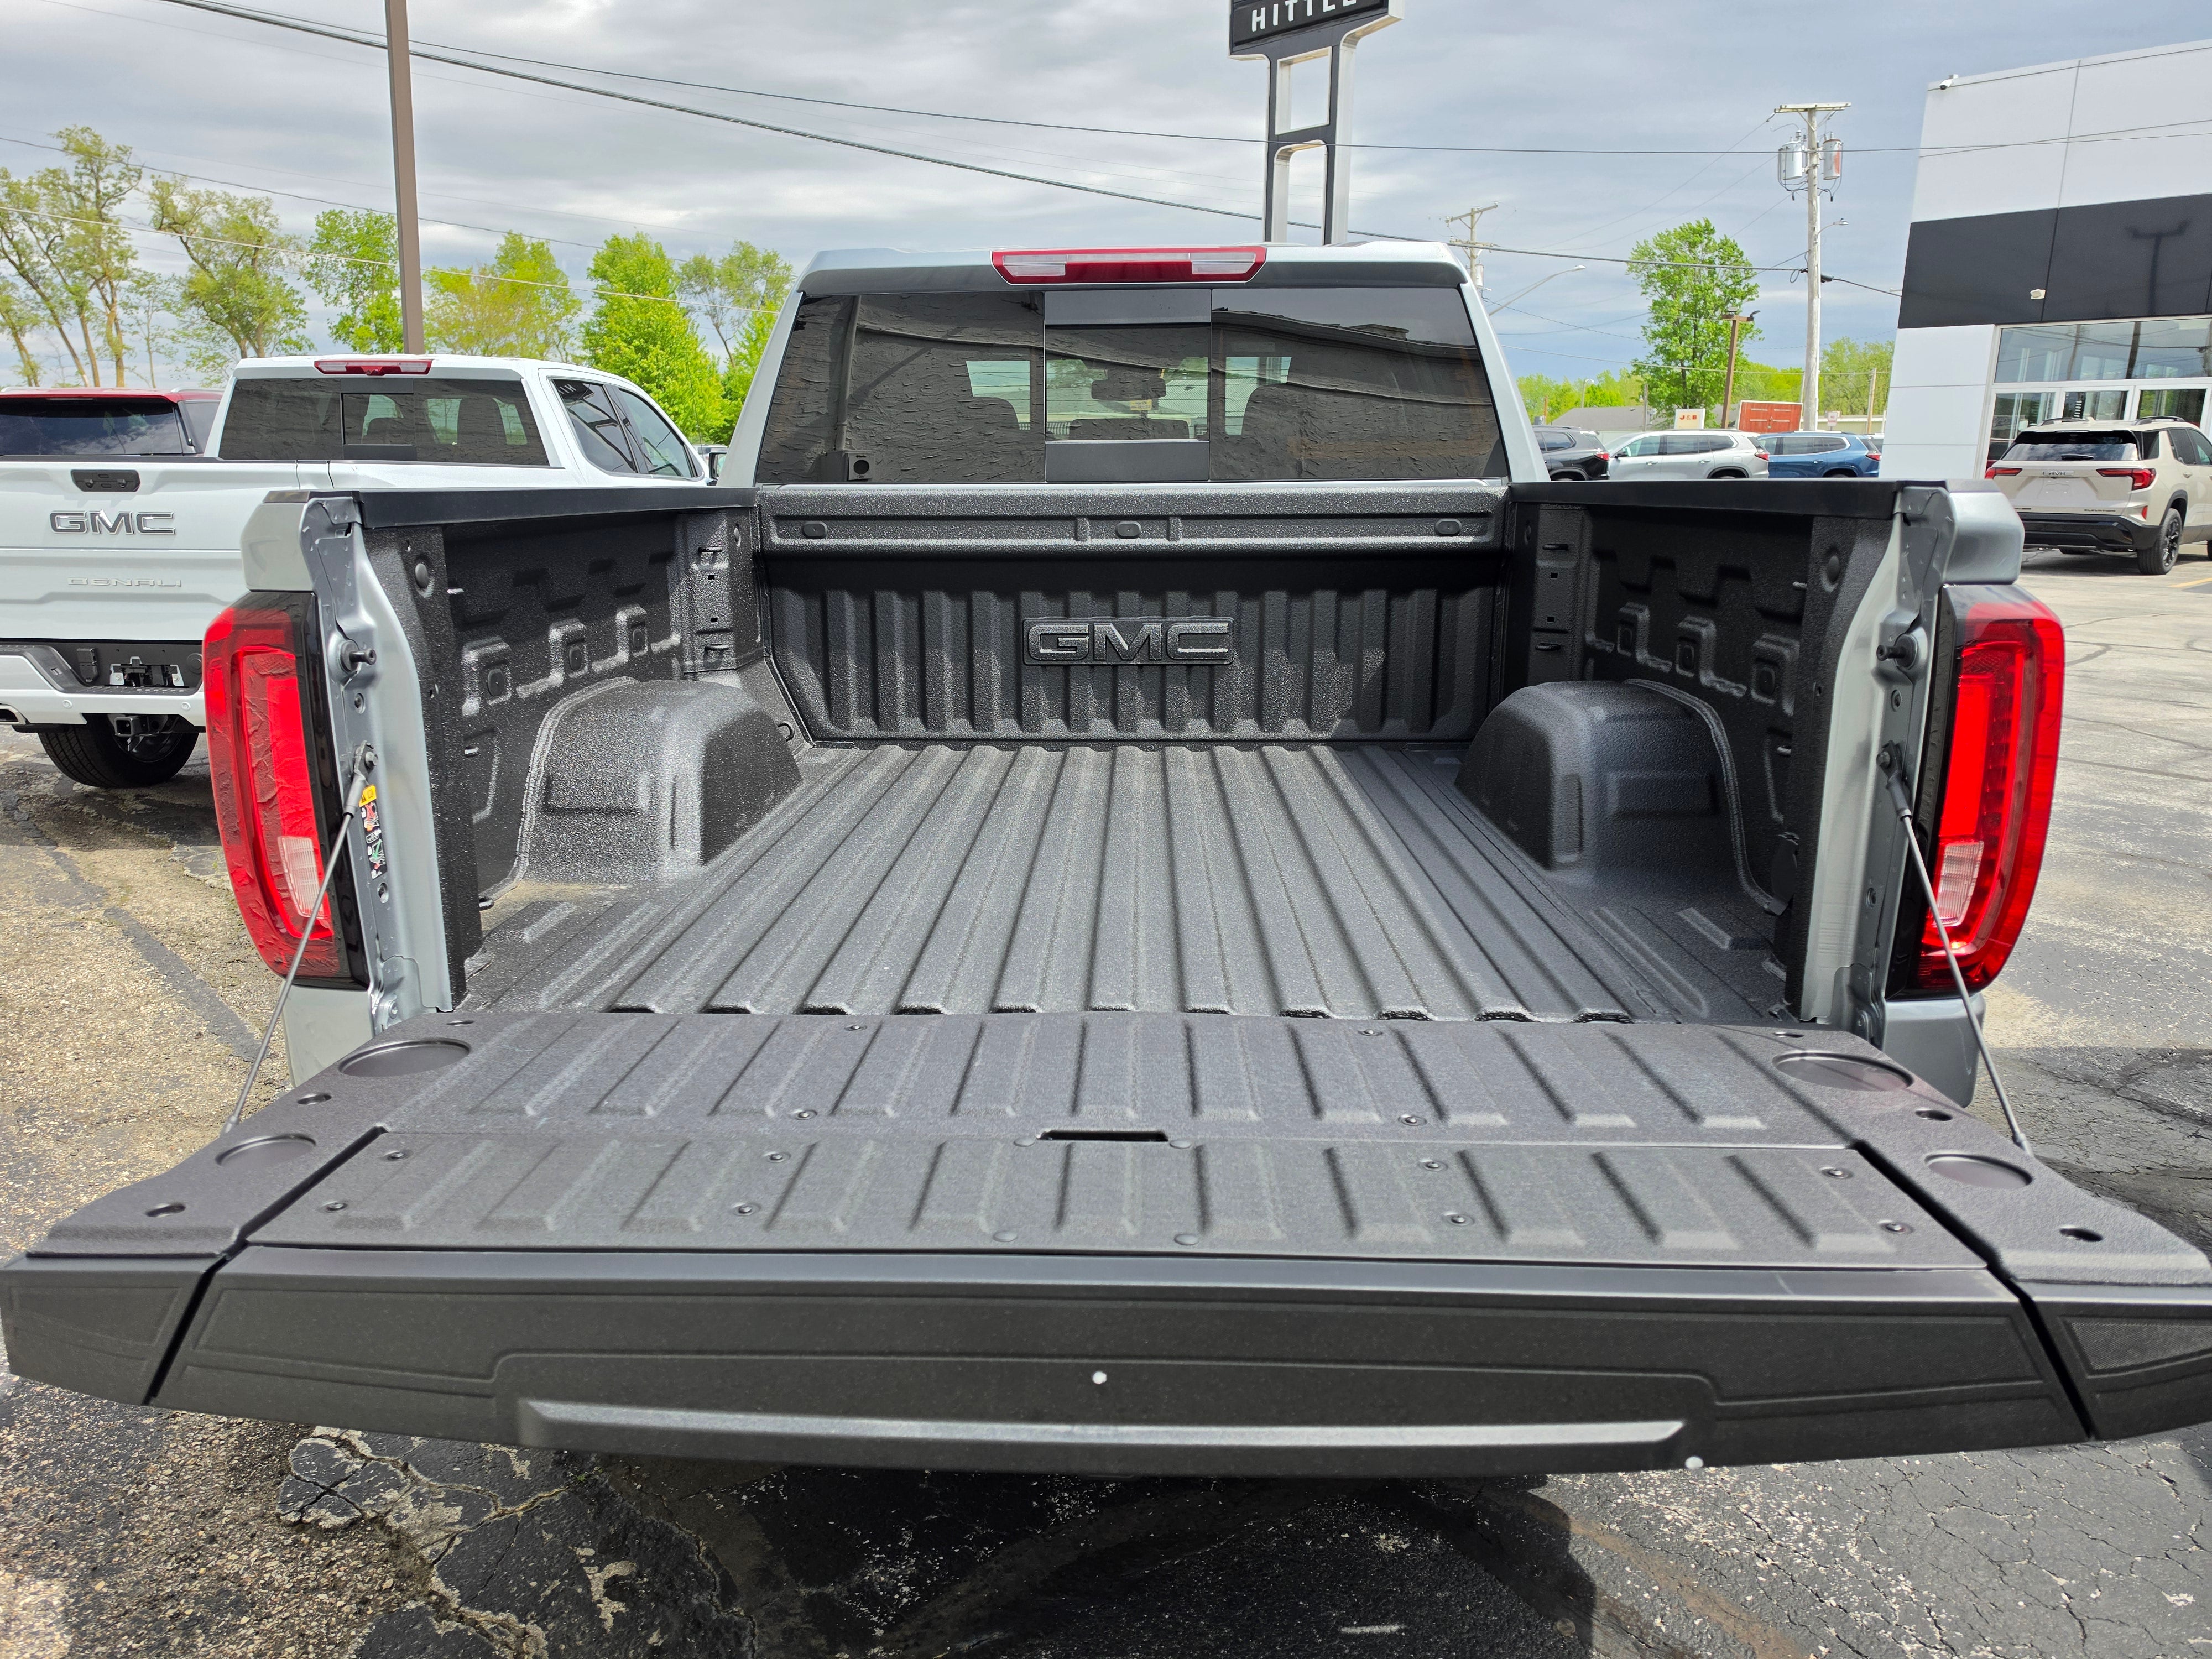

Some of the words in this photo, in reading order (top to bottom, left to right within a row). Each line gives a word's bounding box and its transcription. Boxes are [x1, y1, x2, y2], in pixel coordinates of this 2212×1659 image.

[50, 510, 176, 535] GMC
[68, 577, 182, 587] DENALI
[1028, 623, 1228, 660] GMC
